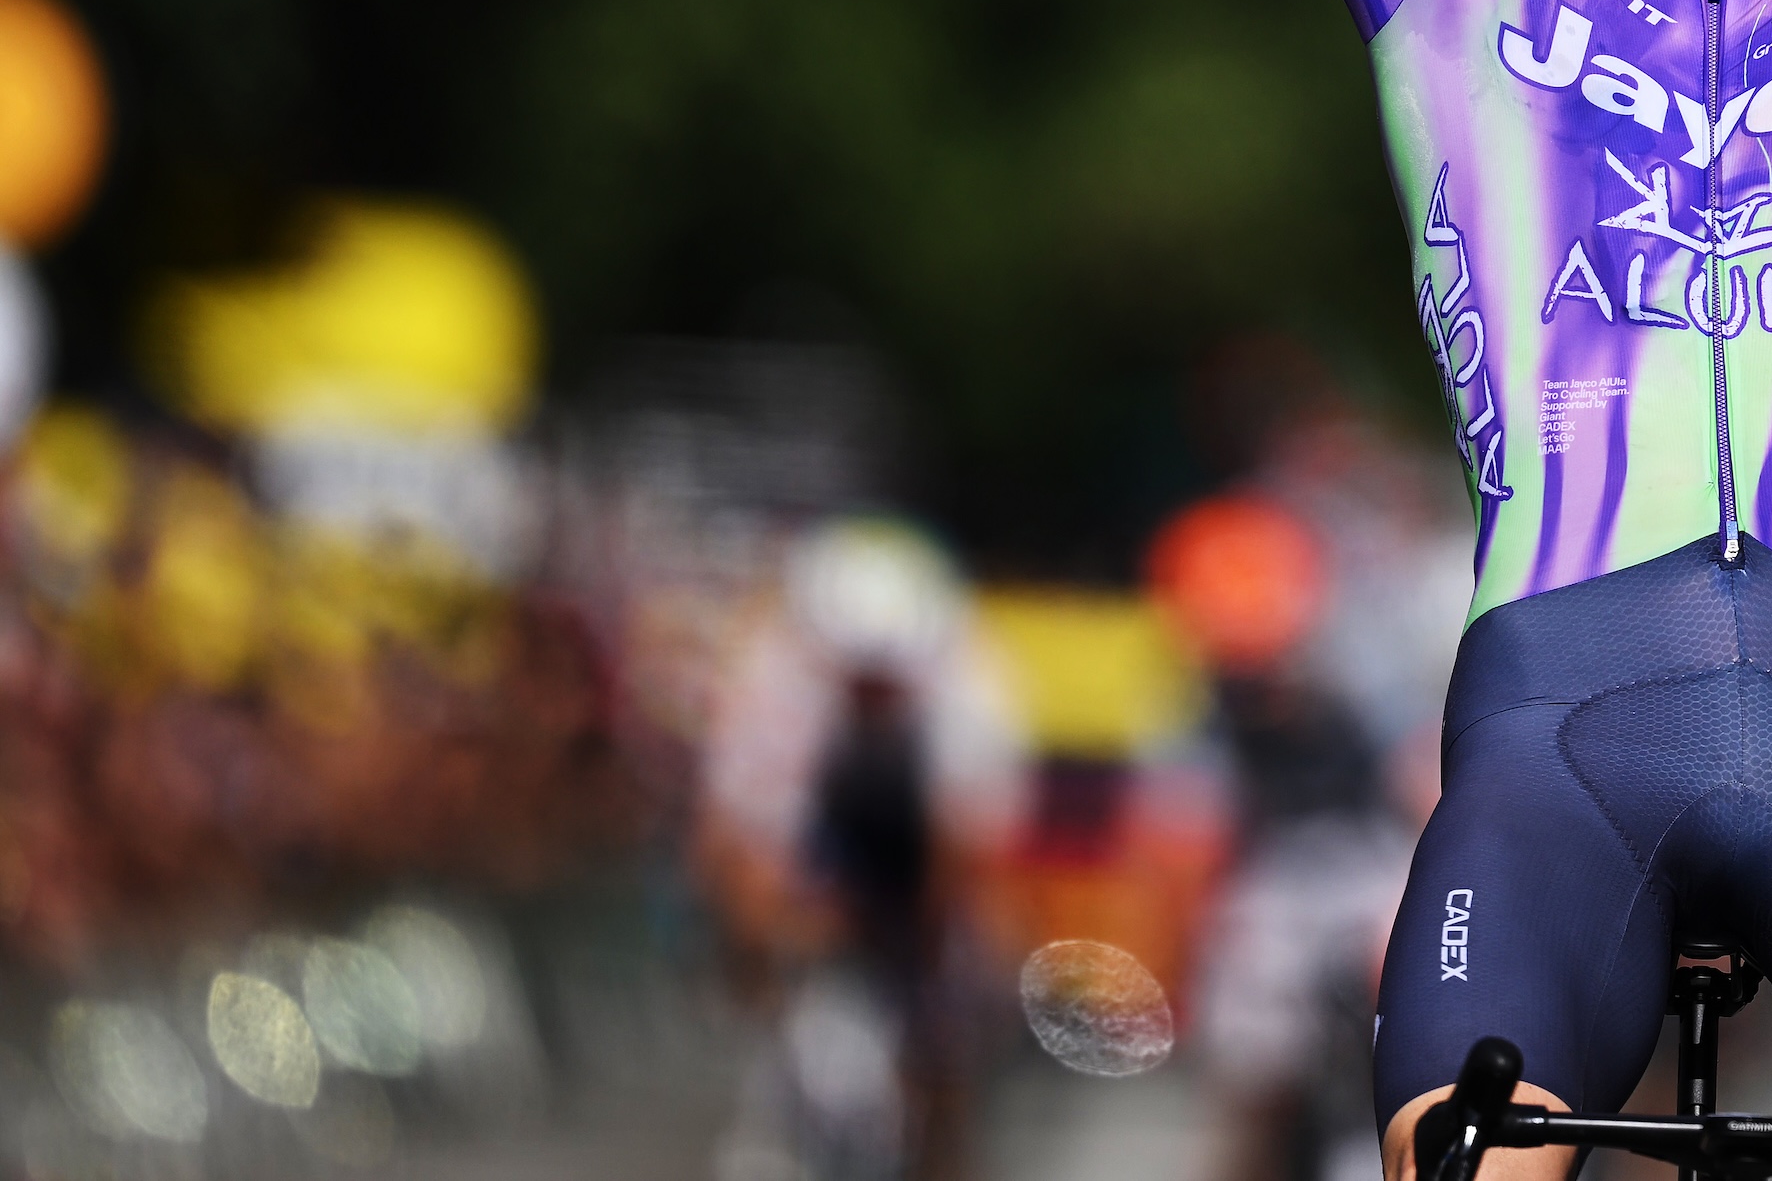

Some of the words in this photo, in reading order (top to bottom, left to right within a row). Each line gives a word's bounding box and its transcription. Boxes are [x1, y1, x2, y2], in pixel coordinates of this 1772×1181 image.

[1543, 380, 1568, 389] Team
[1570, 379, 1597, 389] Jayco
[1542, 391, 1559, 400] Pro
[1560, 389, 1598, 399] Cycling
[1540, 400, 1592, 411] Supported
[1595, 399, 1607, 409] by
[1540, 412, 1566, 422] Giant
[1538, 421, 1576, 433] CADEX
[1441, 888, 1473, 982] CADEX
